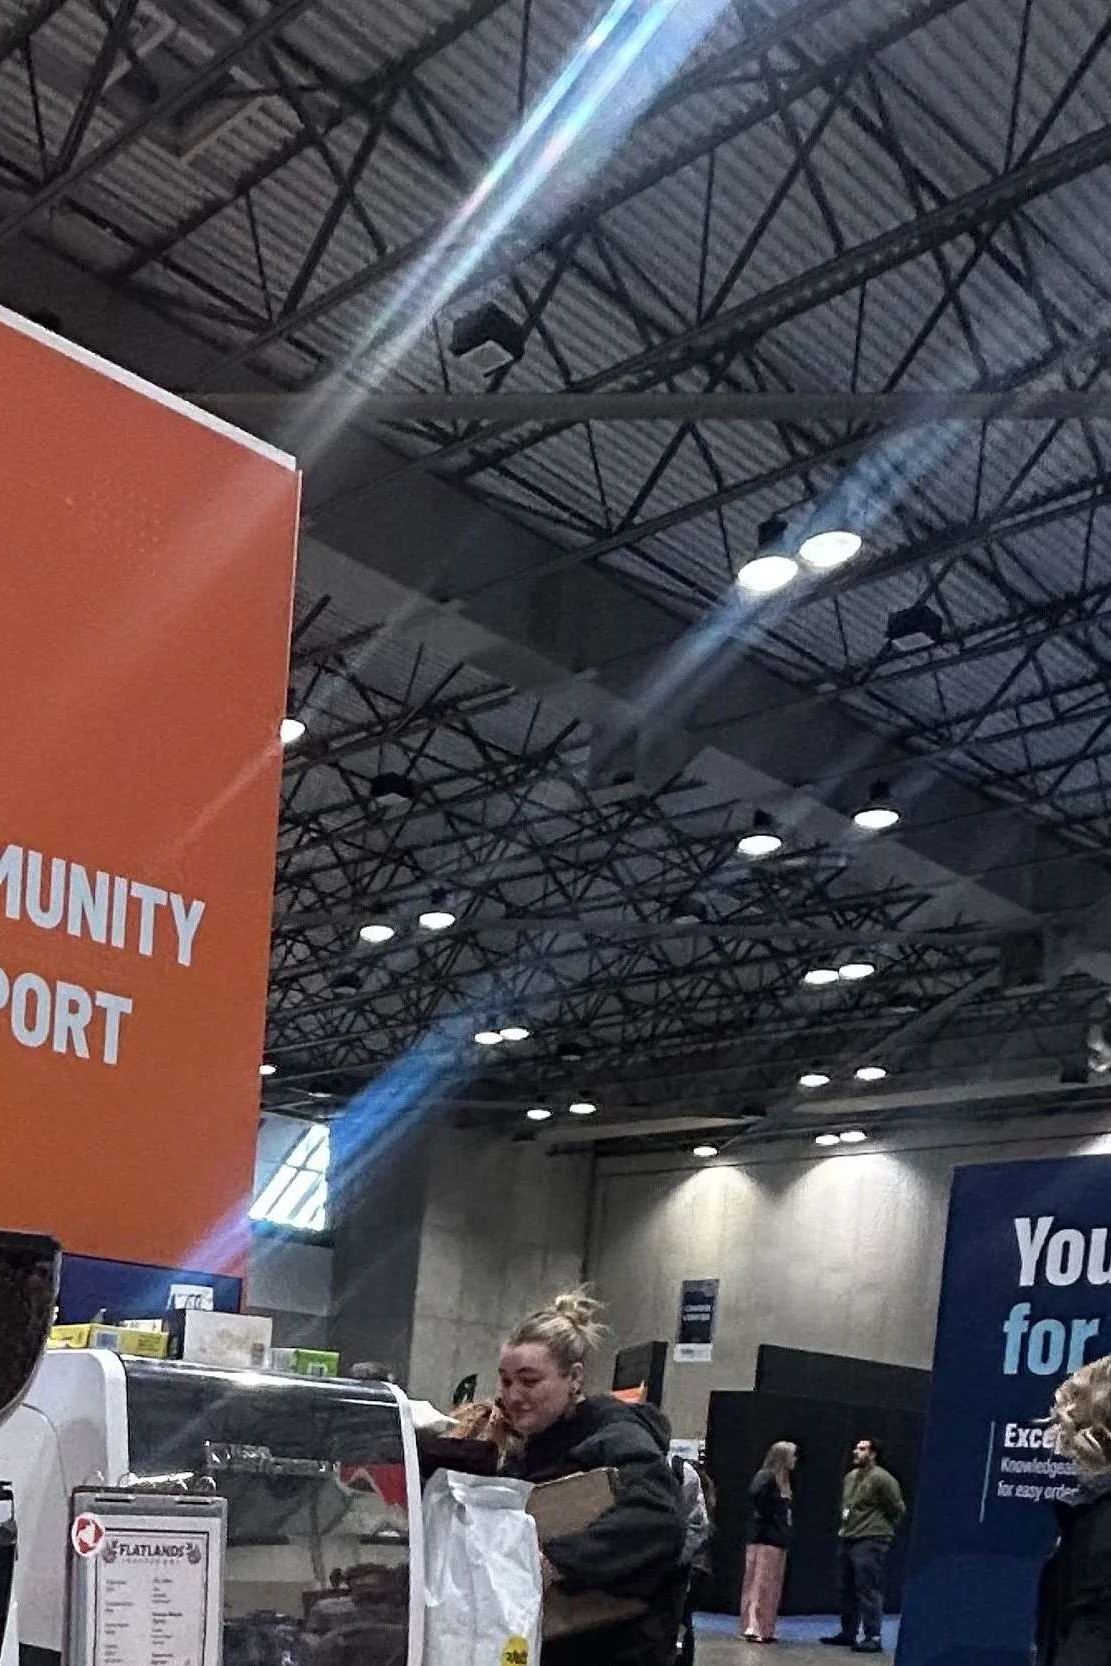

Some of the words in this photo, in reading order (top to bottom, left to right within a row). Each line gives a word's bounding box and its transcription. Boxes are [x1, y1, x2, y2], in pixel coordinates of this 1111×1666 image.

[1014, 1215, 1111, 1287] You
[1002, 1302, 1101, 1376] for
[119, 1544, 185, 1558] FLATLANDS
